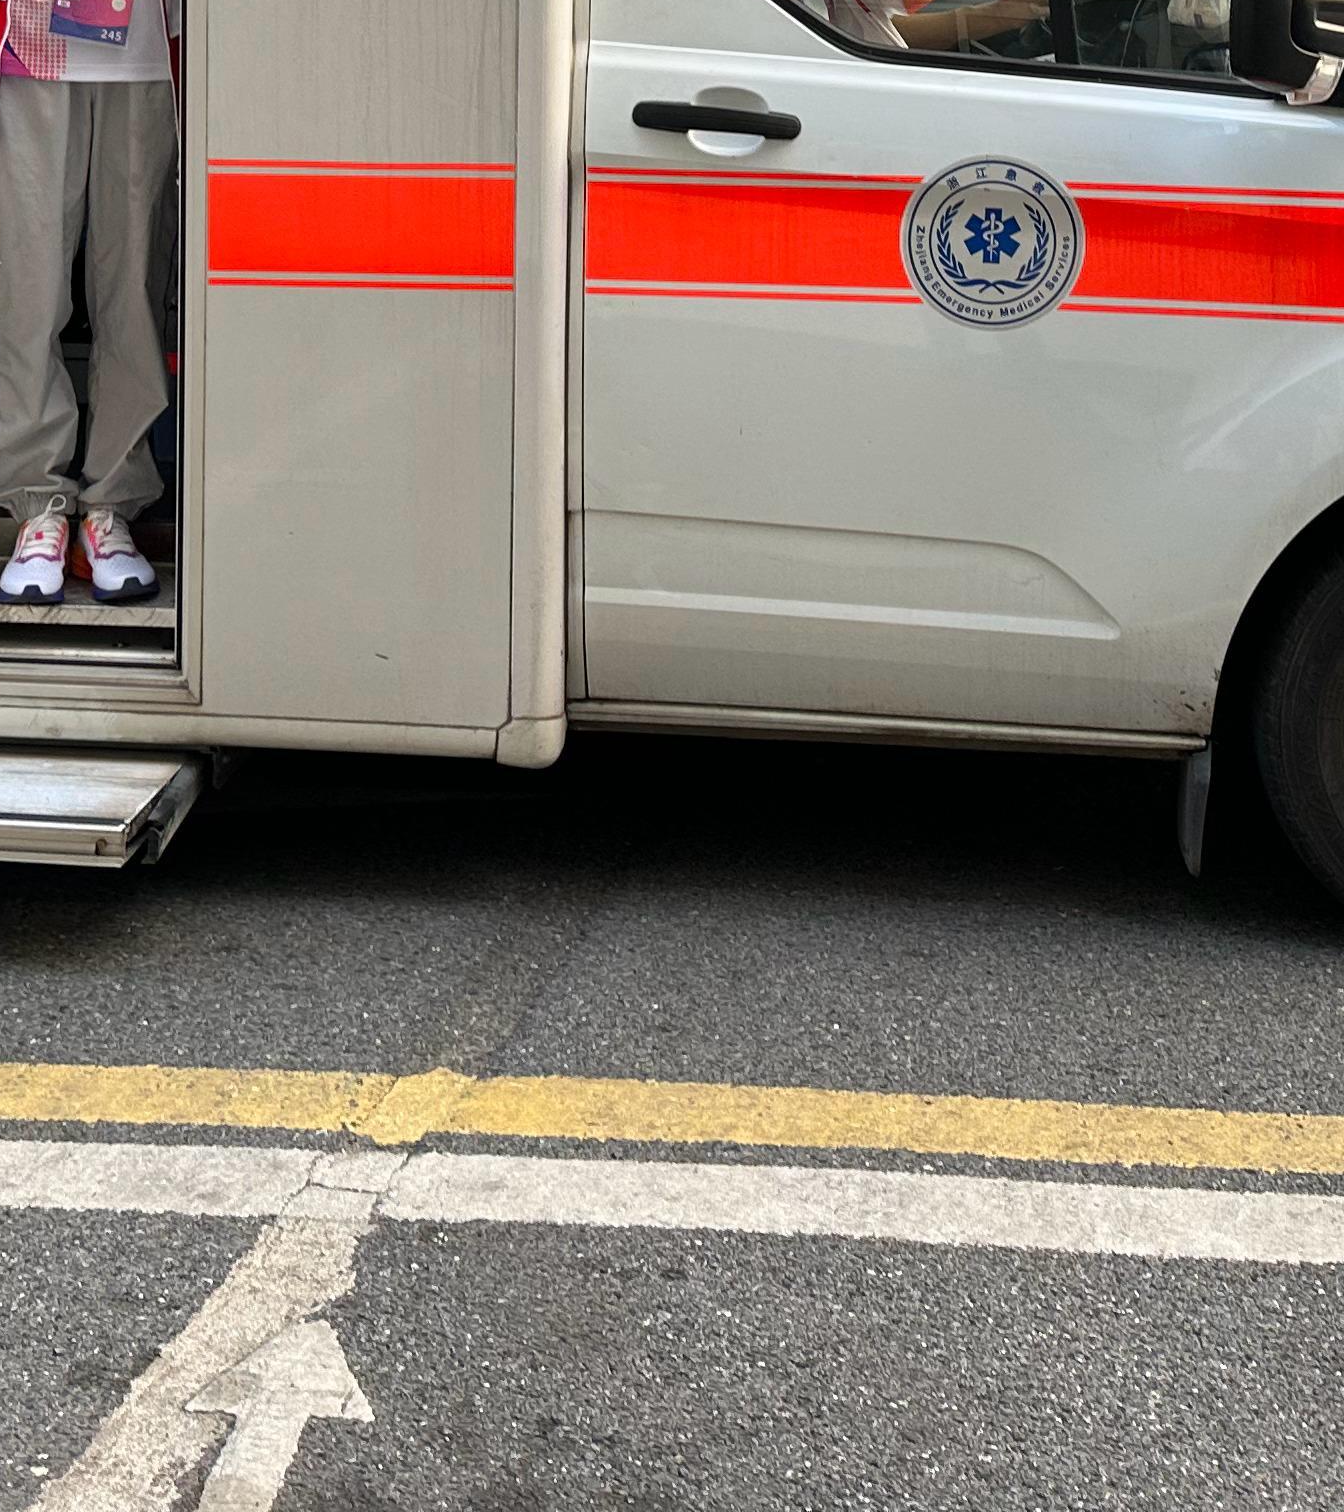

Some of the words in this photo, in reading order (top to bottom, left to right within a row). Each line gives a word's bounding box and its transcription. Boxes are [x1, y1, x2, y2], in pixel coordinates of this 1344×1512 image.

[101, 28, 122, 42] 245
[915, 224, 934, 282] Zhejiang
[931, 281, 994, 319] Emergency
[999, 290, 1044, 318] Medical
[1044, 234, 1070, 291] Services
